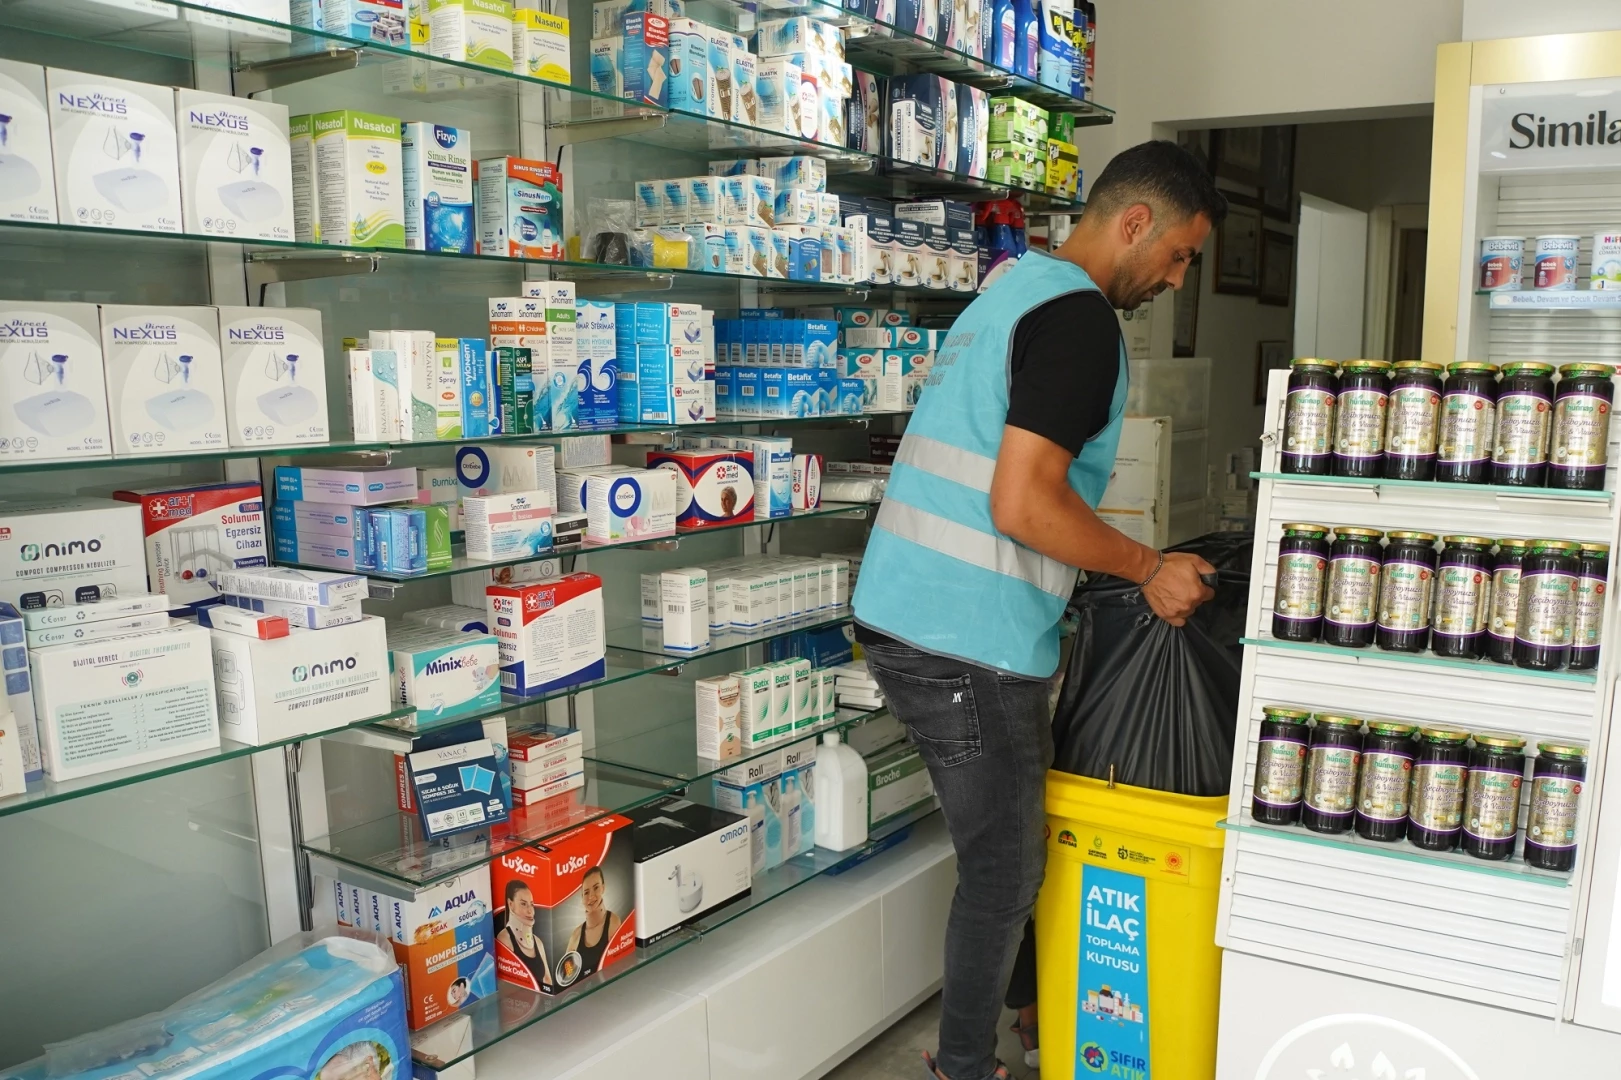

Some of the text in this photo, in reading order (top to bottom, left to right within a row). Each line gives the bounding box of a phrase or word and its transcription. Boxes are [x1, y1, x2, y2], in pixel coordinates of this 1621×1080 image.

[534, 14, 563, 30] Nasatol
[315, 117, 344, 130] Nasatol
[354, 118, 395, 134] Nasatol
[1509, 110, 1621, 149] Simila
[436, 130, 456, 144] Fizyo
[427, 150, 467, 165] Sinus Rinse
[518, 190, 551, 201] SinusNem
[1488, 242, 1519, 251] Bebevit
[1541, 241, 1574, 251] Bebevit
[1512, 295, 1536, 303] Bebek,
[1536, 295, 1560, 303] Devam
[1593, 295, 1616, 303] Devam
[556, 312, 570, 320] Adults
[807, 323, 828, 331] Betafix
[439, 376, 457, 384] Spray
[787, 373, 812, 381] Betafix
[726, 471, 739, 479] med
[168, 506, 192, 516] med
[221, 514, 260, 525] Solunum
[226, 525, 262, 538] Egzersiz
[236, 539, 263, 551] Cihazı
[689, 575, 707, 586] Batticon
[537, 598, 554, 608] med
[501, 606, 513, 614] med
[493, 627, 517, 639] Solunum
[498, 641, 517, 651] gzersiz
[774, 672, 790, 684] Batix
[795, 667, 809, 678] Batix
[823, 674, 834, 682] Batix
[753, 678, 769, 689] Batix
[145, 685, 189, 698] SPECIFICATIONS
[786, 752, 801, 765] Roll
[748, 764, 764, 780] Roll
[876, 768, 901, 786] Broche
[421, 787, 437, 795] SICAK
[442, 782, 459, 791] SOĞUK
[422, 791, 446, 800] KOMPRES
[720, 824, 748, 844] OMRON
[501, 855, 537, 875] Luxor
[556, 856, 589, 876] Luxor
[444, 889, 476, 912] AQUA
[1087, 885, 1140, 913] ATIK
[458, 909, 478, 924] SOĞUK
[1086, 902, 1140, 941] İLAÇ
[430, 922, 448, 935] SICAK
[425, 934, 484, 967] KOMPRES JEL
[607, 937, 634, 957] Neck Collar
[1086, 934, 1140, 956] TOPLAMA
[1086, 951, 1140, 974] KUTUSU
[498, 962, 529, 978] Neck Collar
[1110, 1050, 1146, 1070] SIFIR
[1110, 1066, 1146, 1080] ATIK
